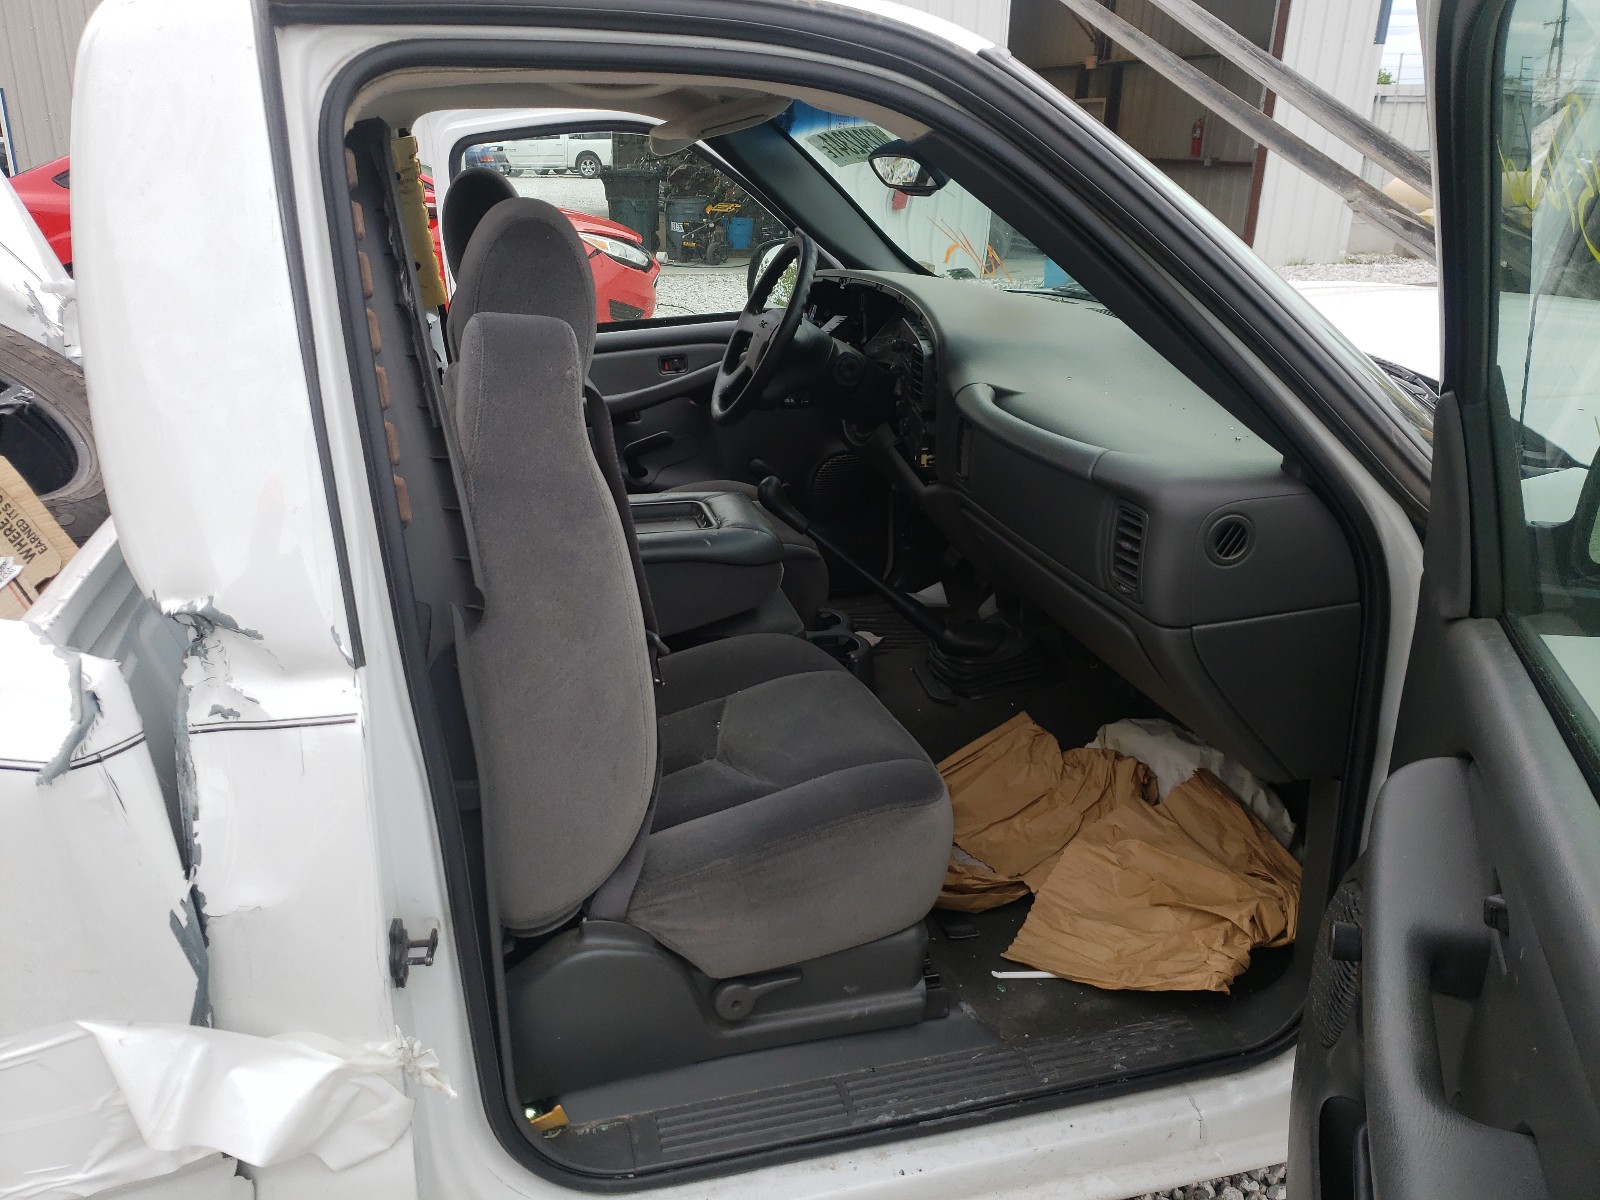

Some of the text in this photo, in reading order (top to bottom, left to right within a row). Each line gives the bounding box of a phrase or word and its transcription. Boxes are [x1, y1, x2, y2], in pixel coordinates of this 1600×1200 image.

[0, 518, 37, 565] WHERE
[2, 503, 48, 555] EARNED ITS
